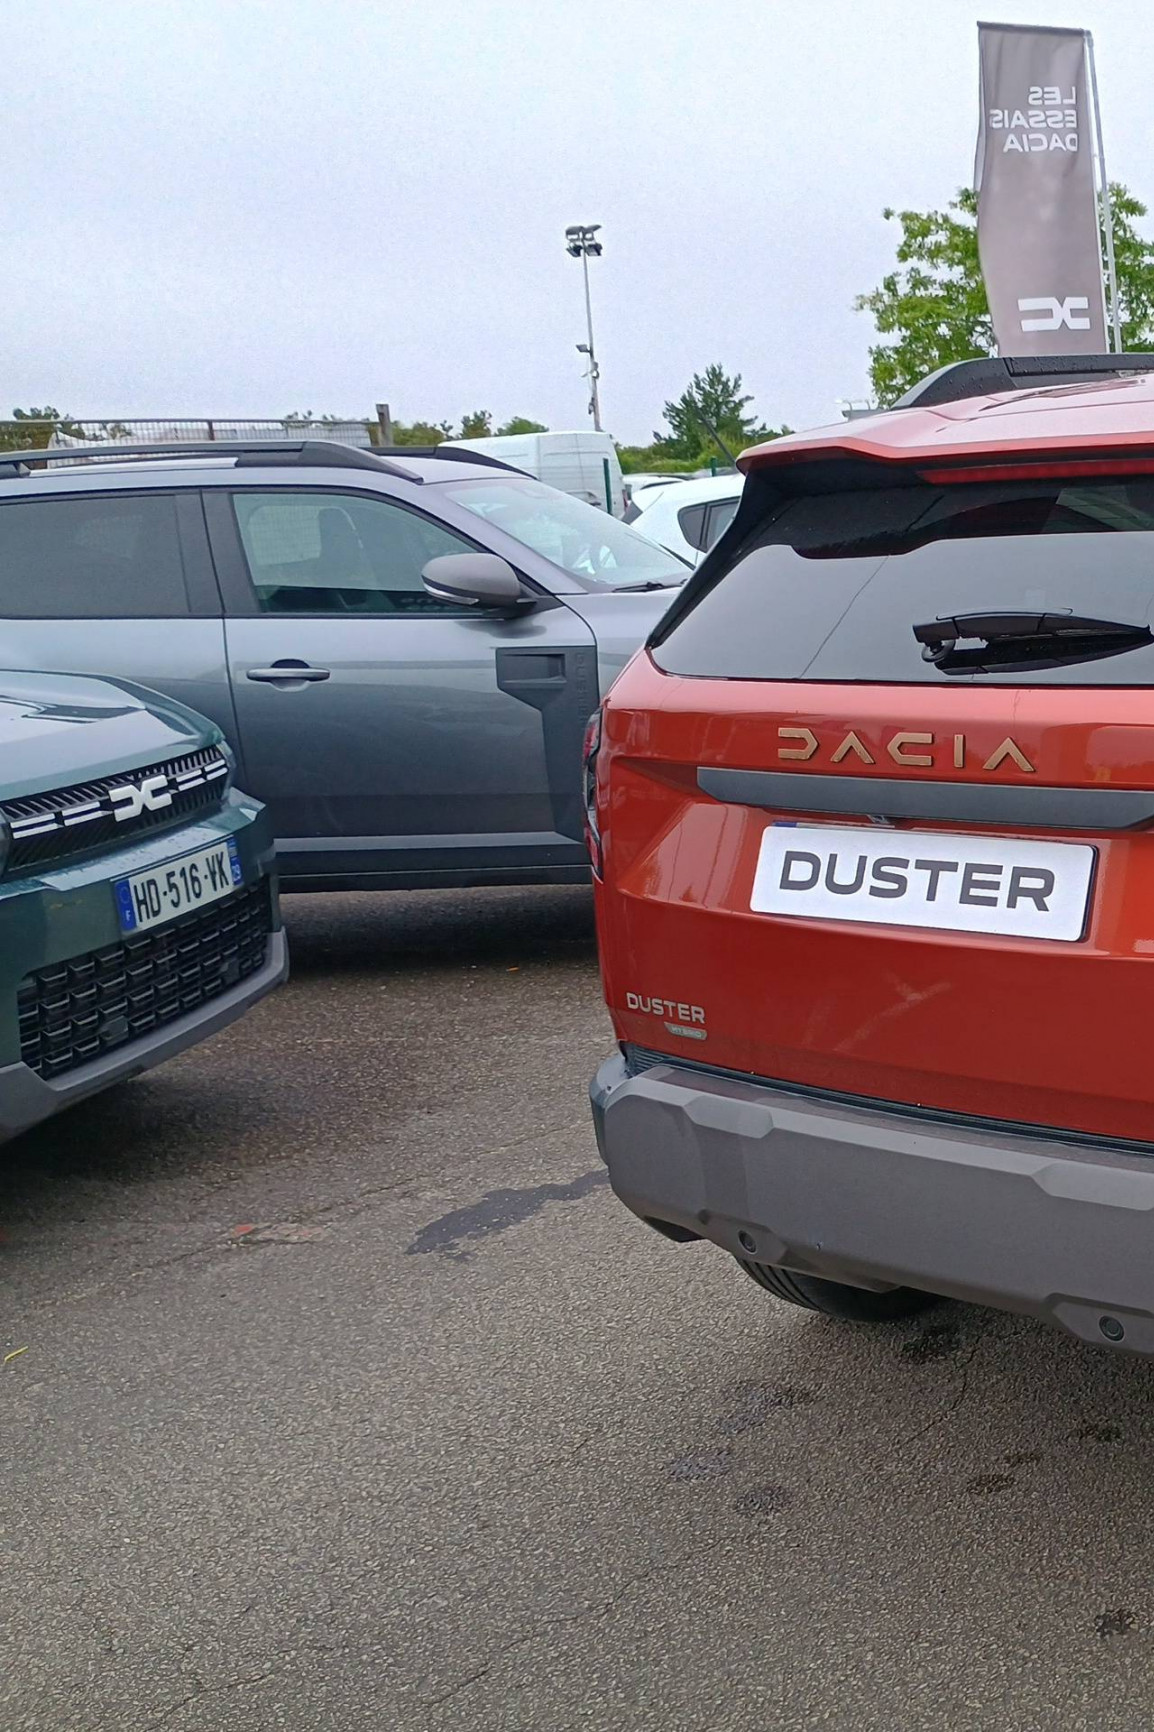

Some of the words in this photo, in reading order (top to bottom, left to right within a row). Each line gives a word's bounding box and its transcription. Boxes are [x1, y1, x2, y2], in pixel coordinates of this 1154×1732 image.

[777, 727, 1036, 773] DACIA
[133, 851, 230, 923] HD-516-VK
[778, 850, 1056, 913] DUSTER
[626, 992, 706, 1025] DUSTER
